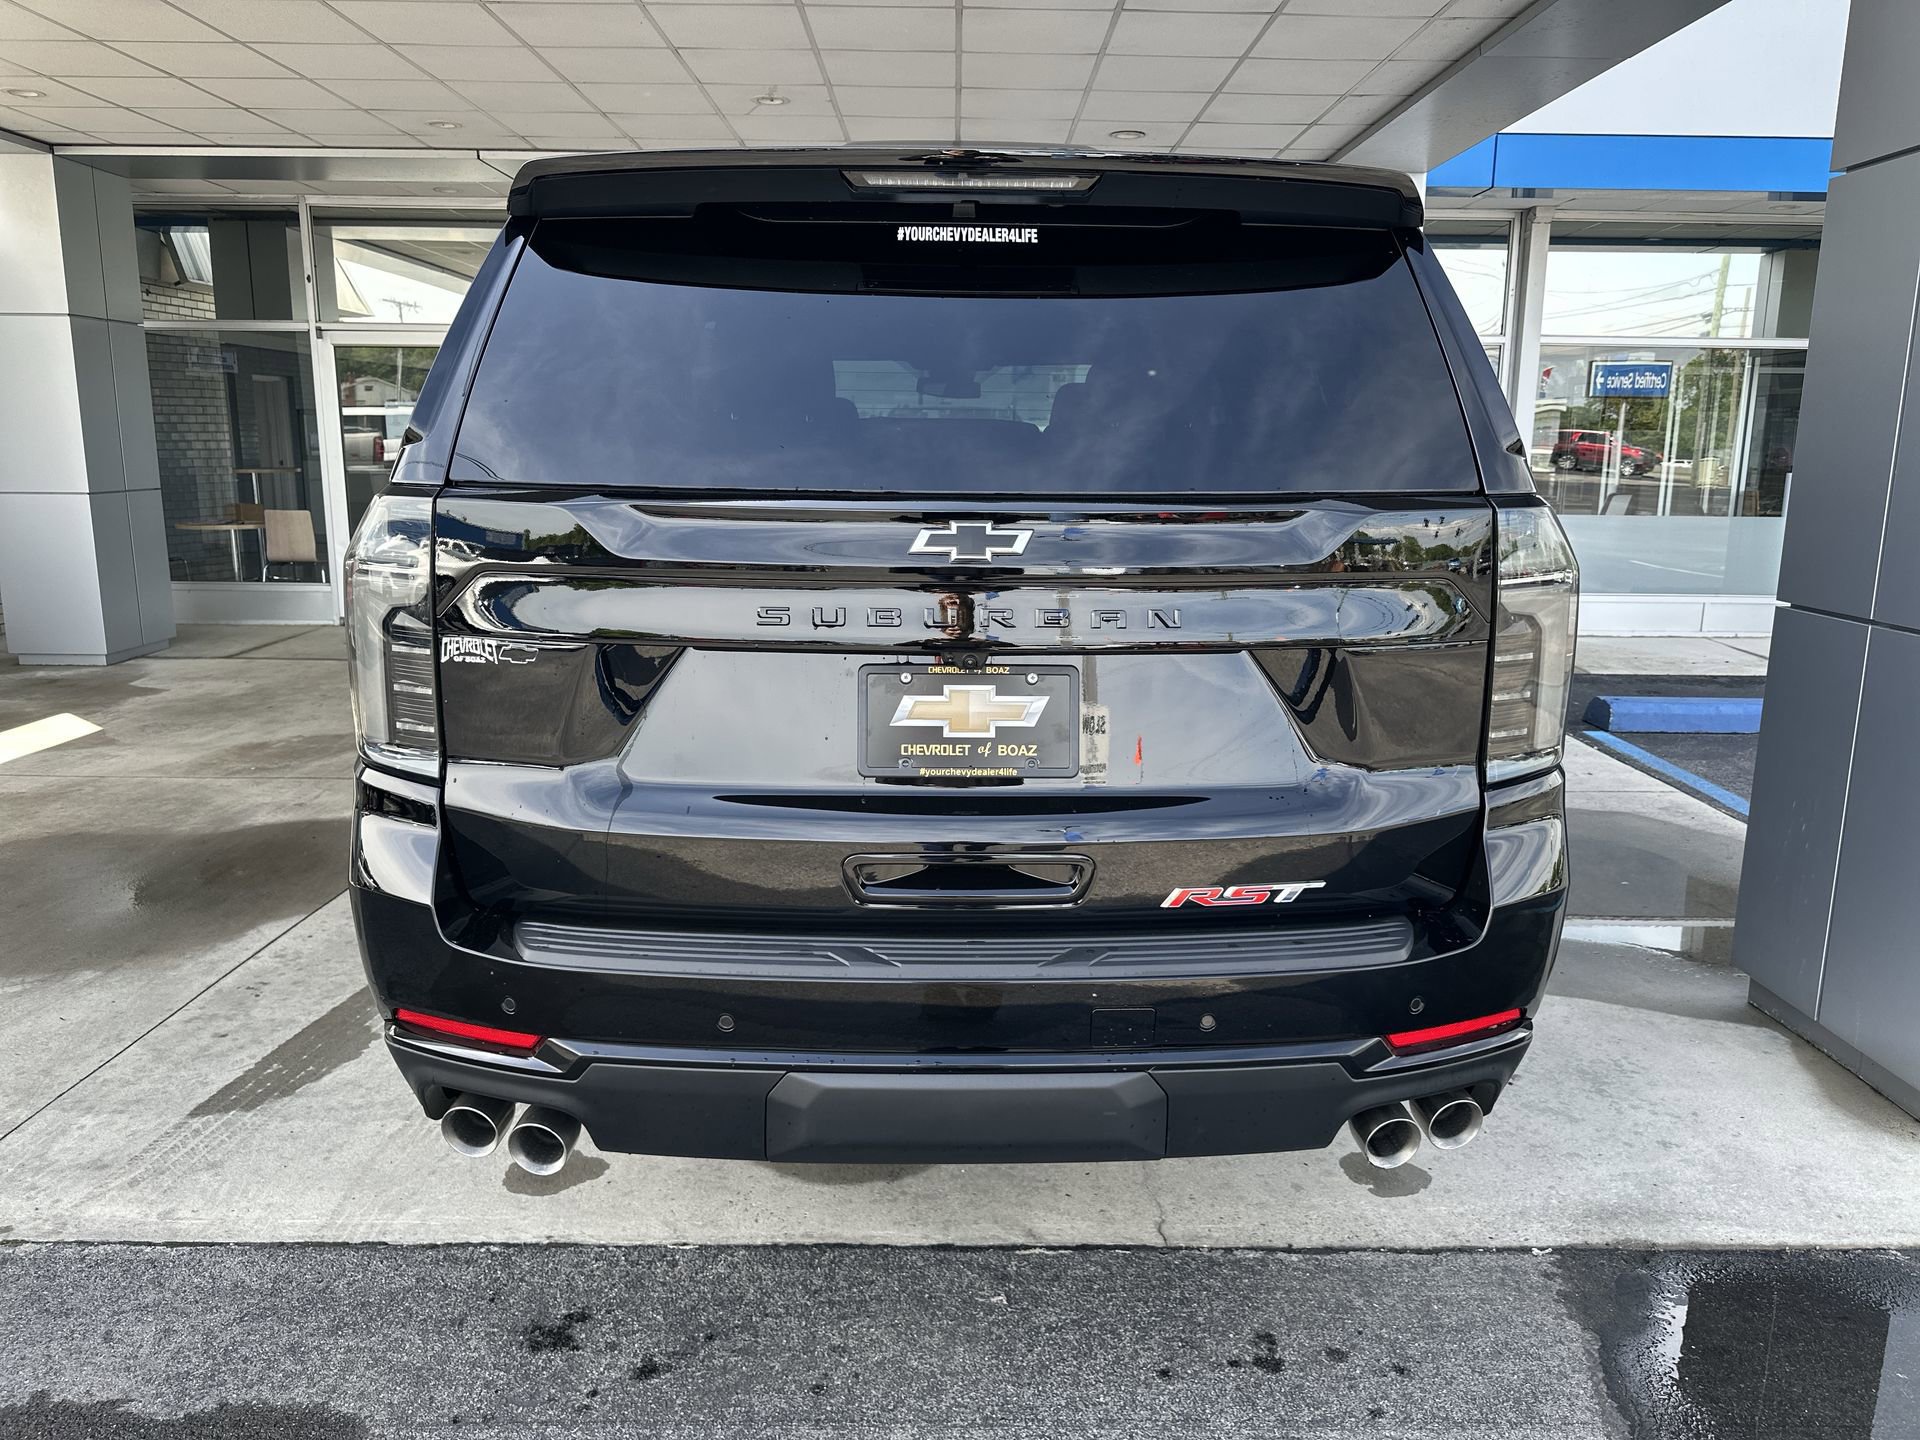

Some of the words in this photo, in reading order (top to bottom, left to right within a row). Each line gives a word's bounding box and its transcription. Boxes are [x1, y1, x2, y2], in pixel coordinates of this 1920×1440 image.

[896, 226, 1039, 243] #YOURCHEVYDEALER4LIFE
[756, 606, 1183, 630] SUBURBAN
[440, 637, 498, 664] CHEVROLET
[986, 666, 1010, 674] BOAZ
[900, 744, 971, 756] CHEVROLET
[977, 741, 992, 757] of
[998, 744, 1038, 756] BOAZ
[919, 767, 1018, 777] #yourchevydealer4life
[1160, 880, 1326, 908] RST
